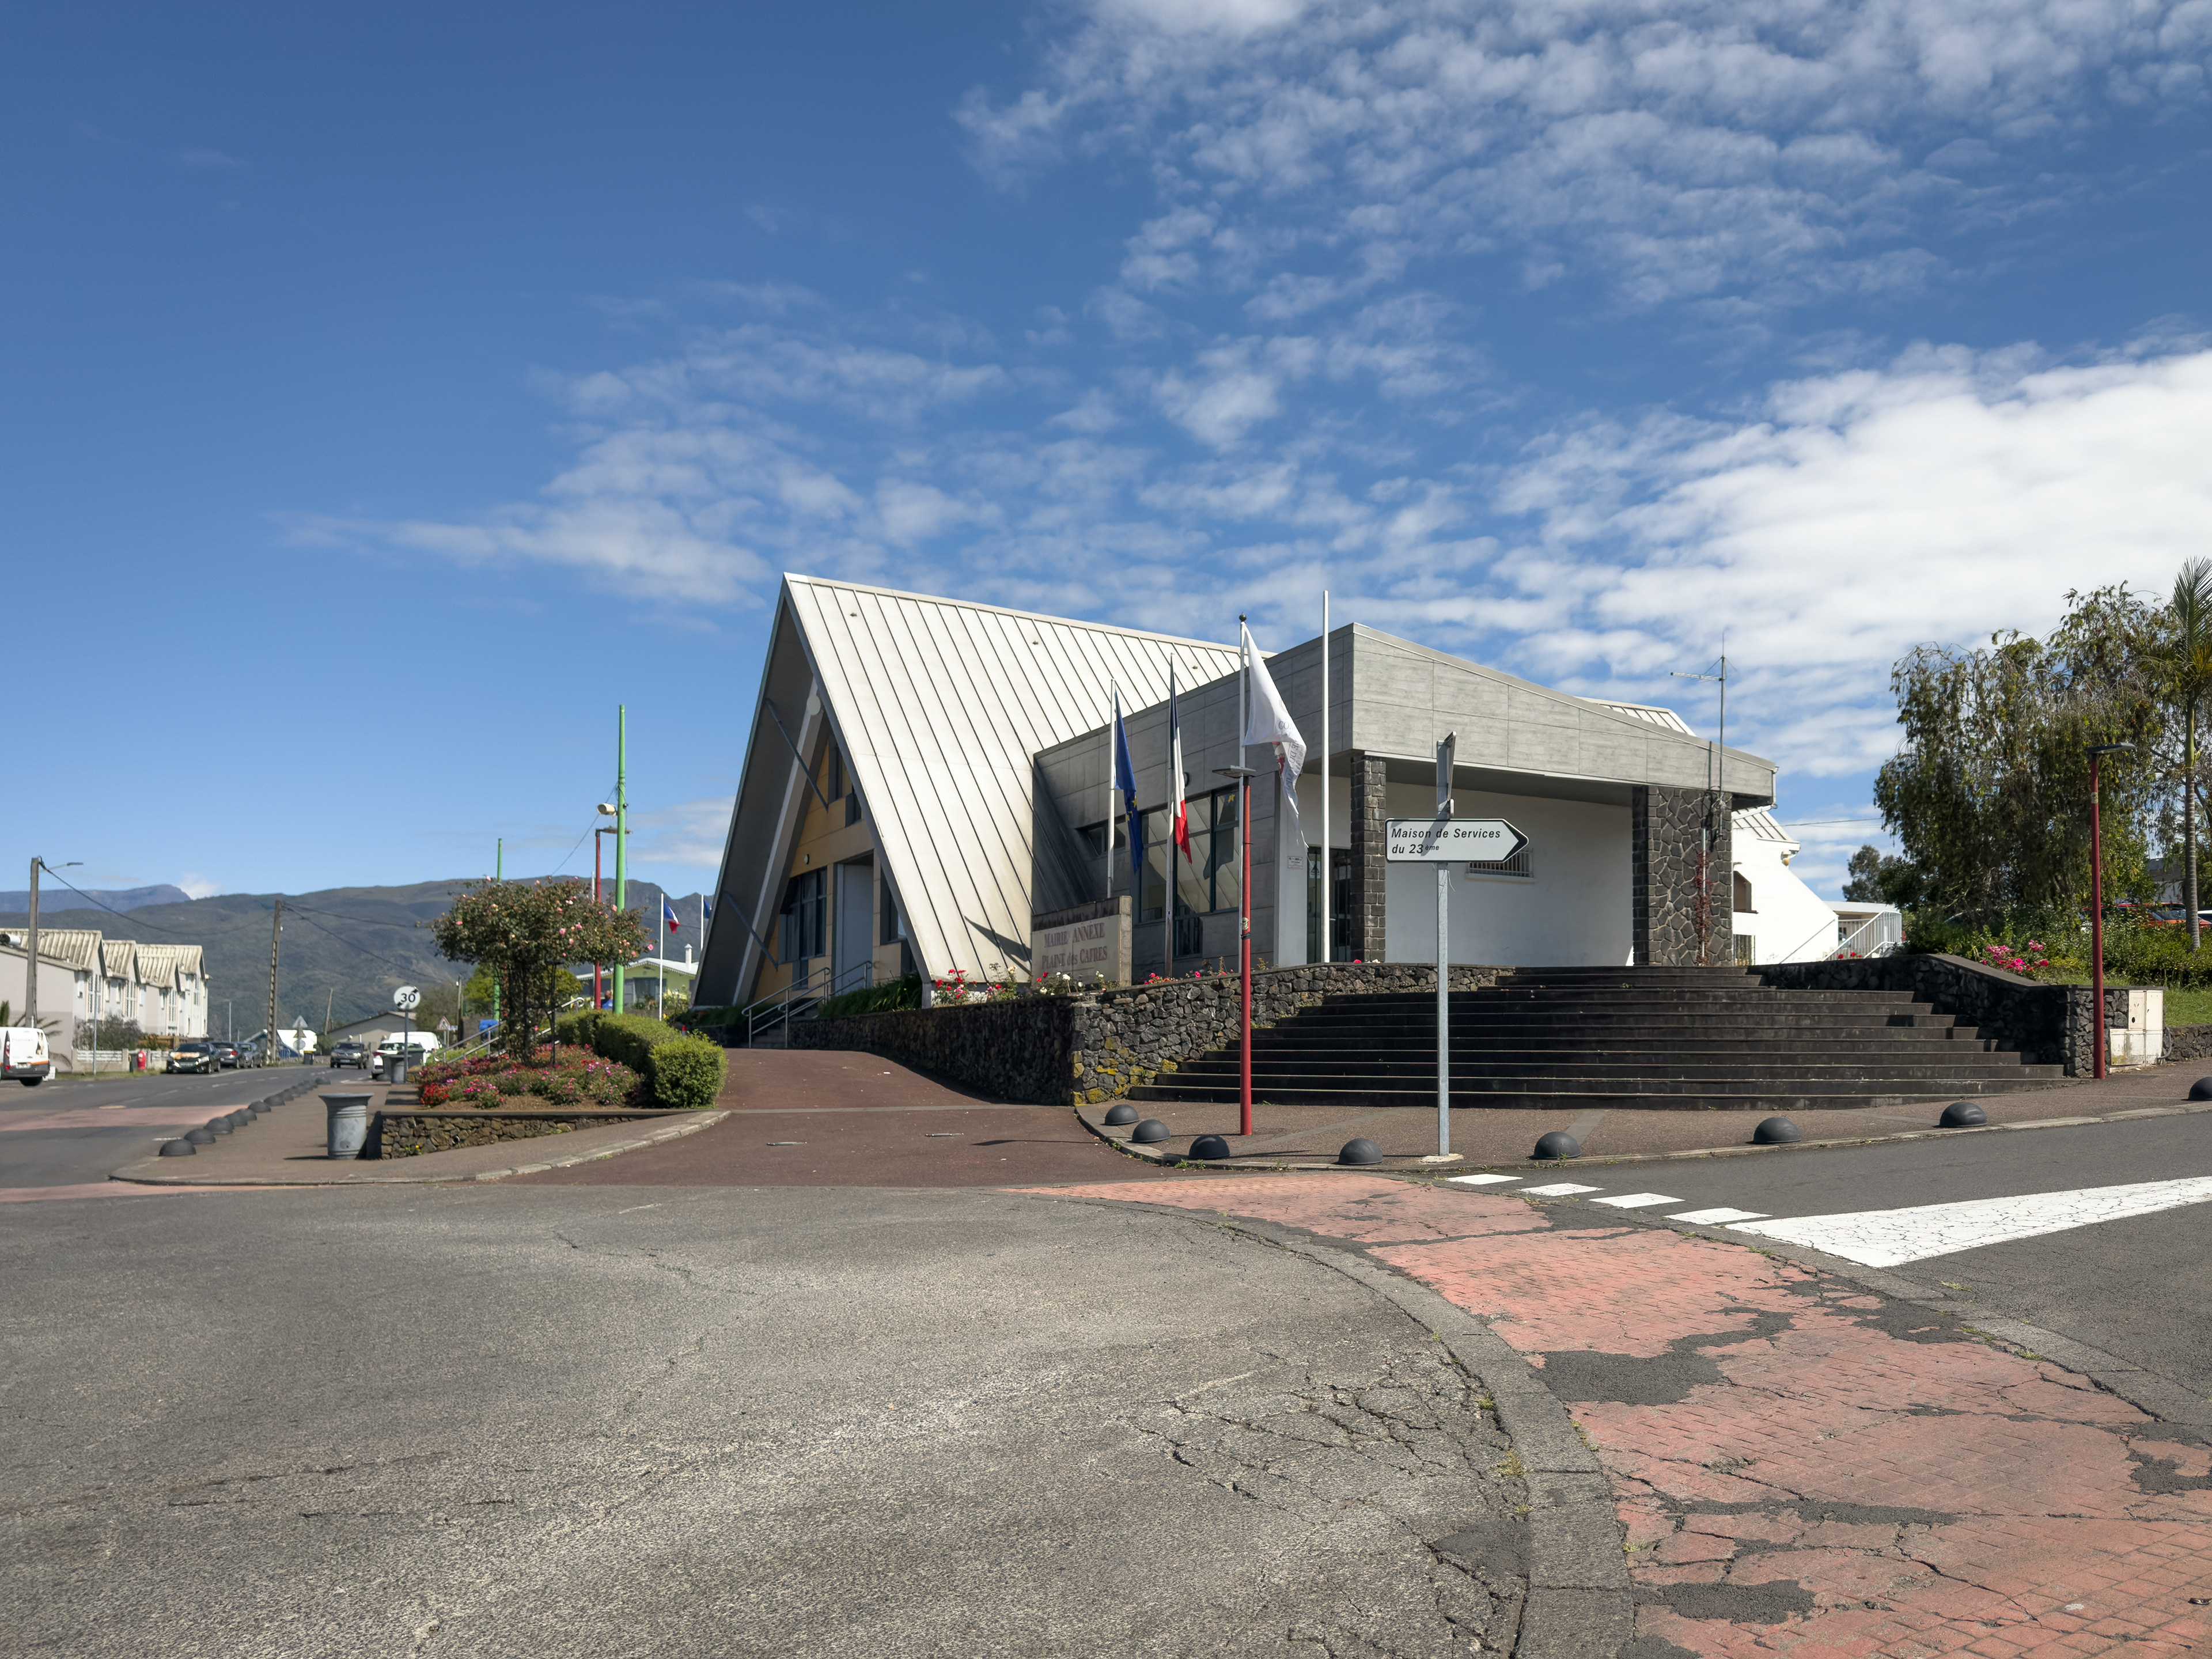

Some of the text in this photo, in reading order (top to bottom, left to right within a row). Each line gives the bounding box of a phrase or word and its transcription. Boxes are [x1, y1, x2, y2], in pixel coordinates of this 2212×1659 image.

[1391, 828, 1501, 838] Maison de Services
[1392, 844, 1405, 854] du
[1044, 922, 1105, 948] MAIRIE ANNEXE
[1041, 946, 1108, 969] PLAINE des CAFRES
[400, 993, 416, 1002] 30
